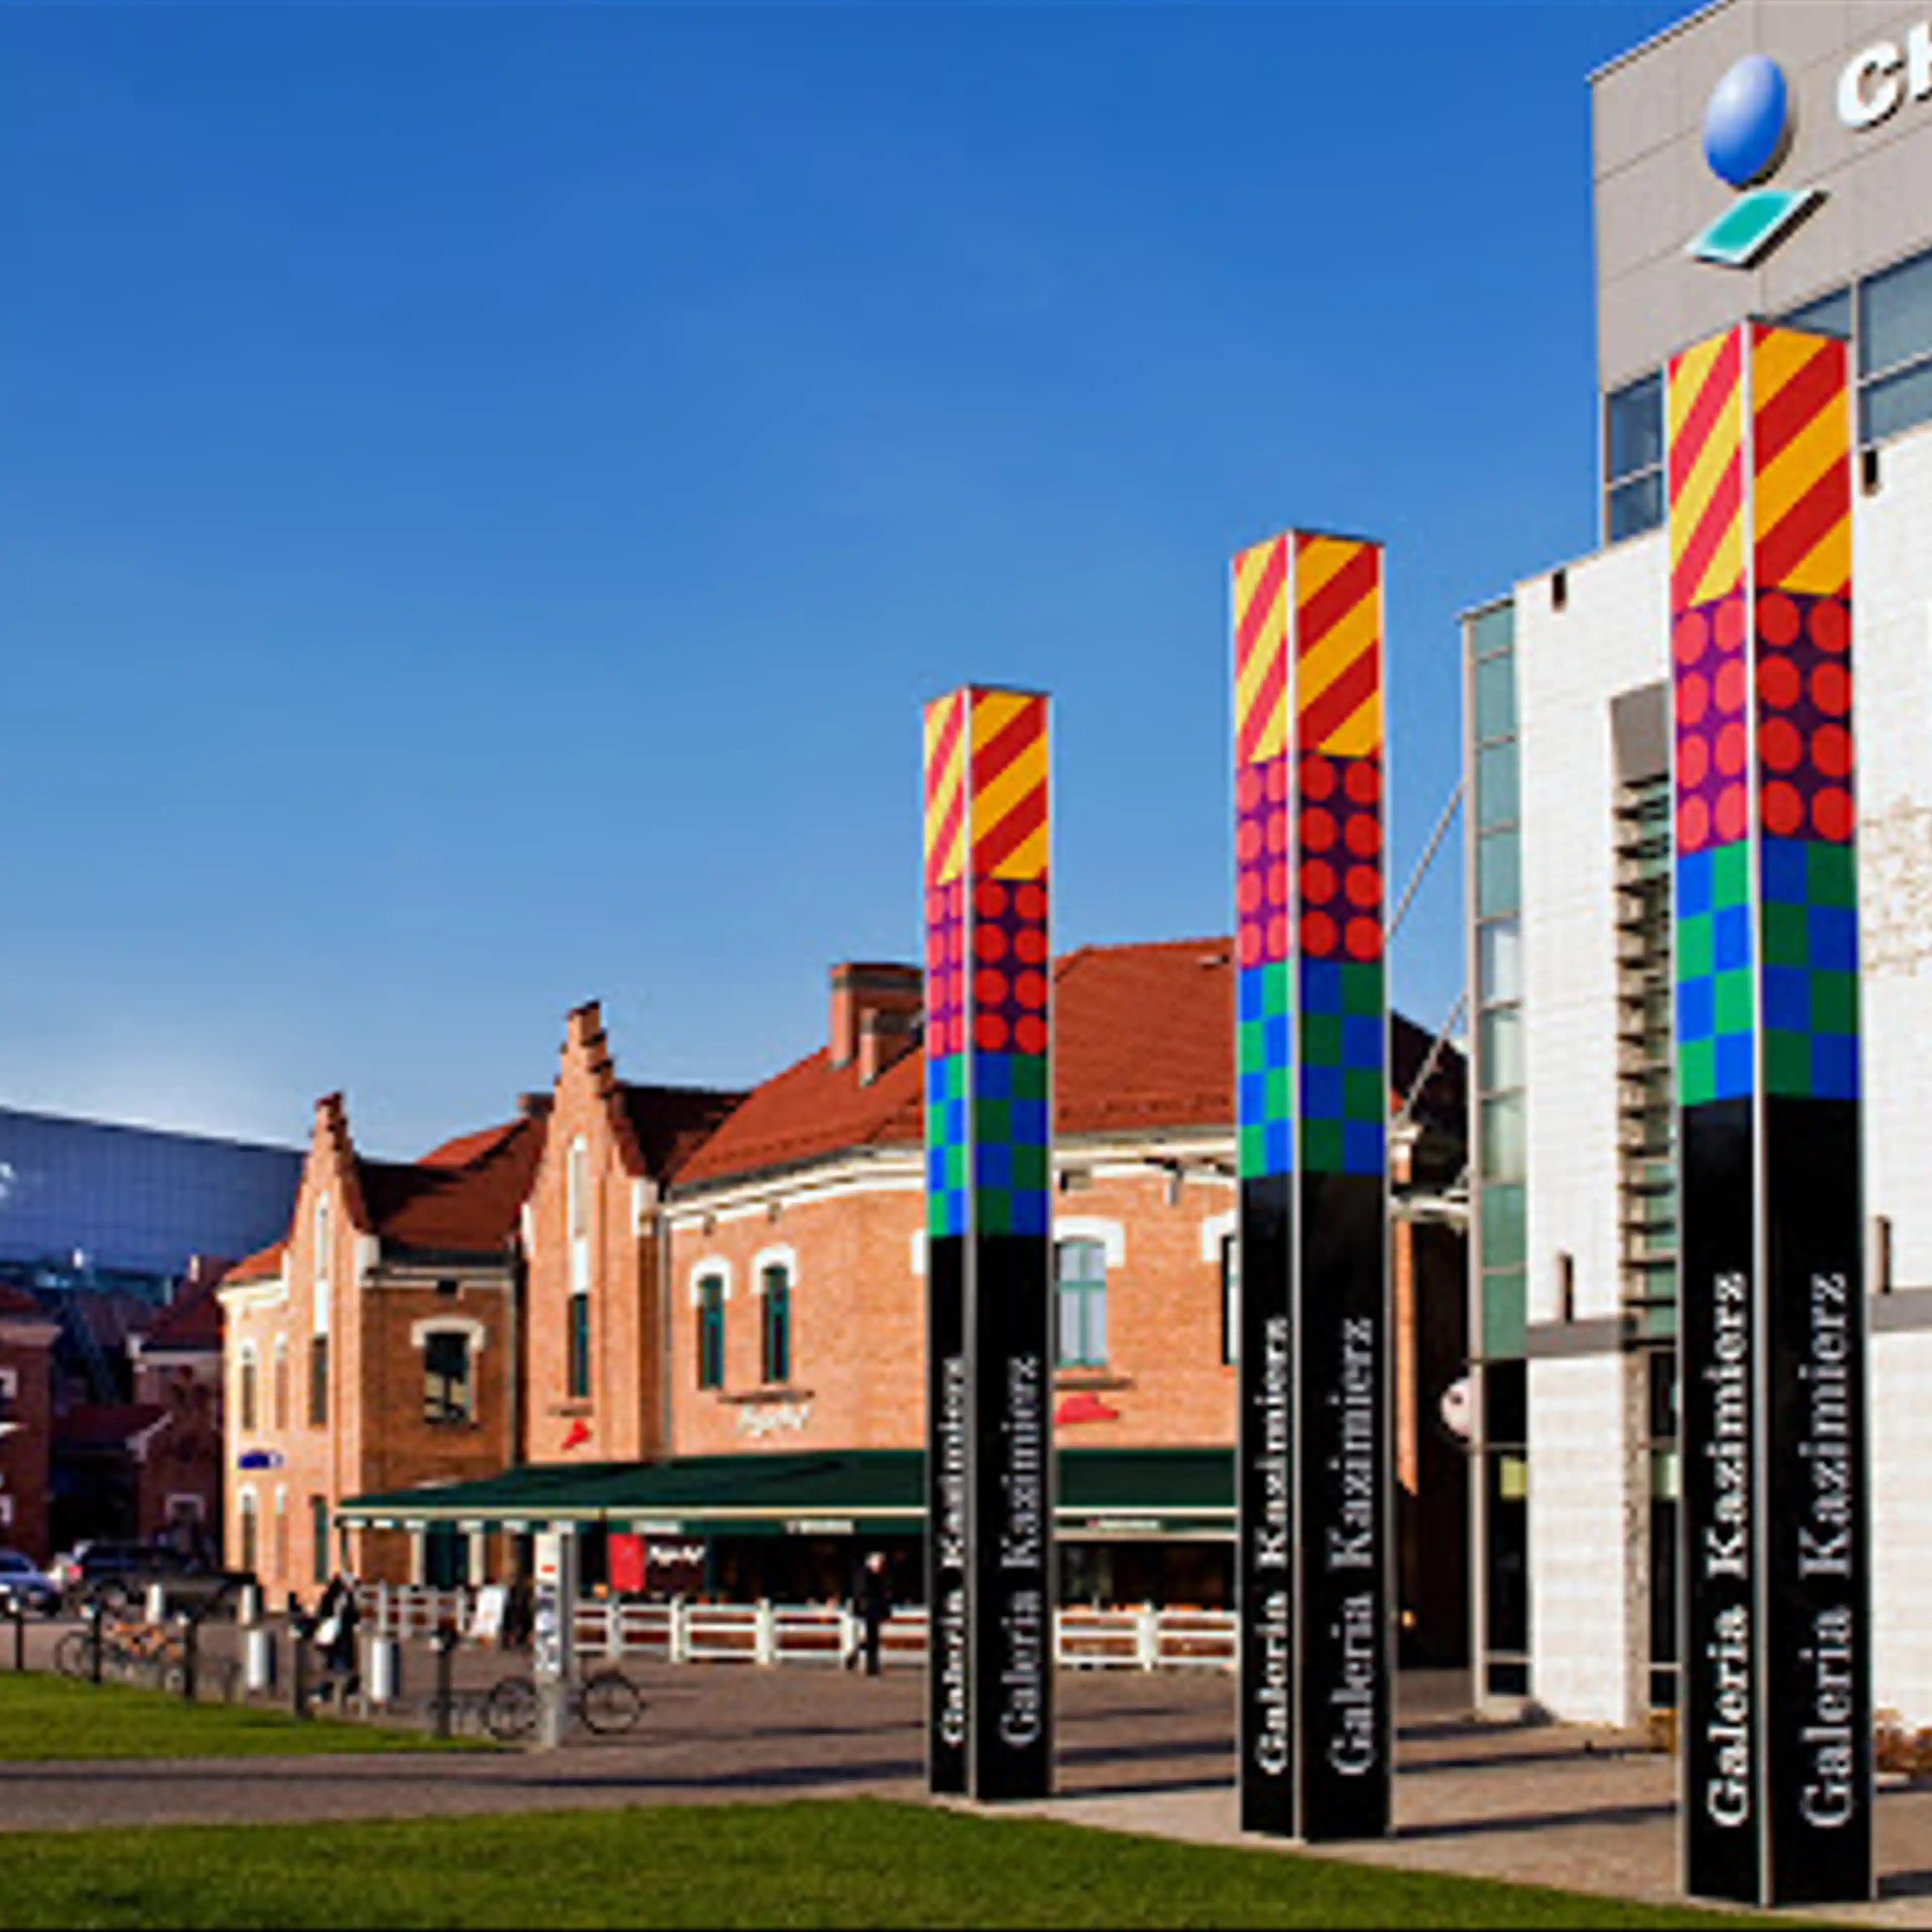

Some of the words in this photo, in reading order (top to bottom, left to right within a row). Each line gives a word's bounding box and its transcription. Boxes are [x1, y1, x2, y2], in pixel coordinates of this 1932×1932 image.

[939, 1356, 964, 1567] Kazimierz
[1001, 1355, 1040, 1568] Kazimierz
[1254, 1315, 1288, 1569] Kazimierz
[1328, 1317, 1374, 1569] Kazimierz
[1705, 1271, 1748, 1578] Kazimierz
[1799, 1273, 1850, 1578] Kazimierz
[940, 1590, 964, 1745] Galeria
[1001, 1591, 1040, 1745] Galeria
[1255, 1591, 1288, 1775] Galeria
[1331, 1592, 1374, 1775] Galeria
[1706, 1604, 1748, 1826] Galeria
[1800, 1608, 1853, 1827] Galeria
